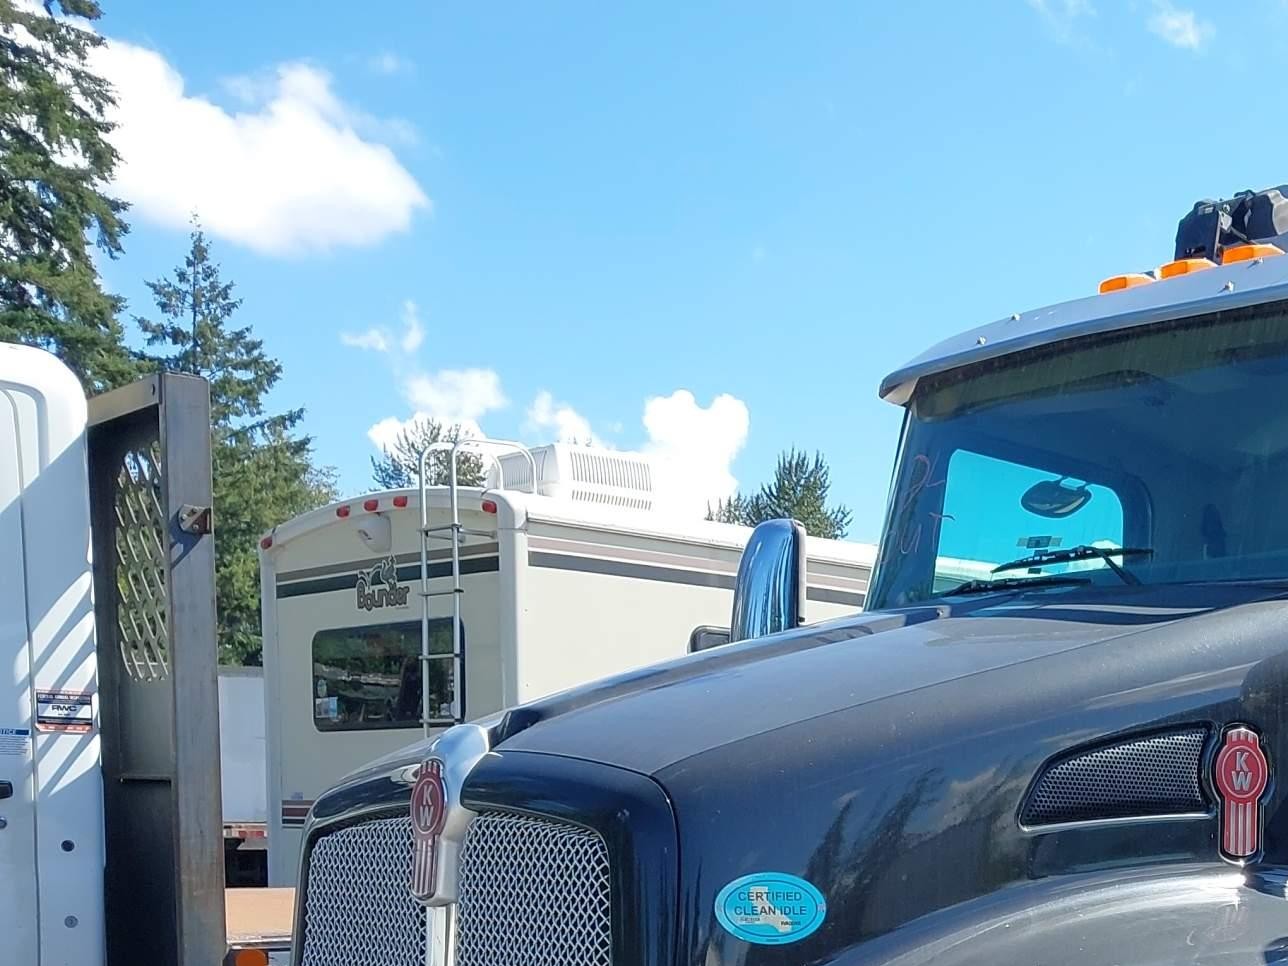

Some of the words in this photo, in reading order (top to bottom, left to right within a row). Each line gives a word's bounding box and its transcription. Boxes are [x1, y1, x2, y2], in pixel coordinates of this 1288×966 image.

[357, 580, 410, 612] Bounder
[737, 891, 803, 902] CERTIFIED
[734, 905, 776, 916] CLEAN
[780, 905, 808, 916] IDLE
